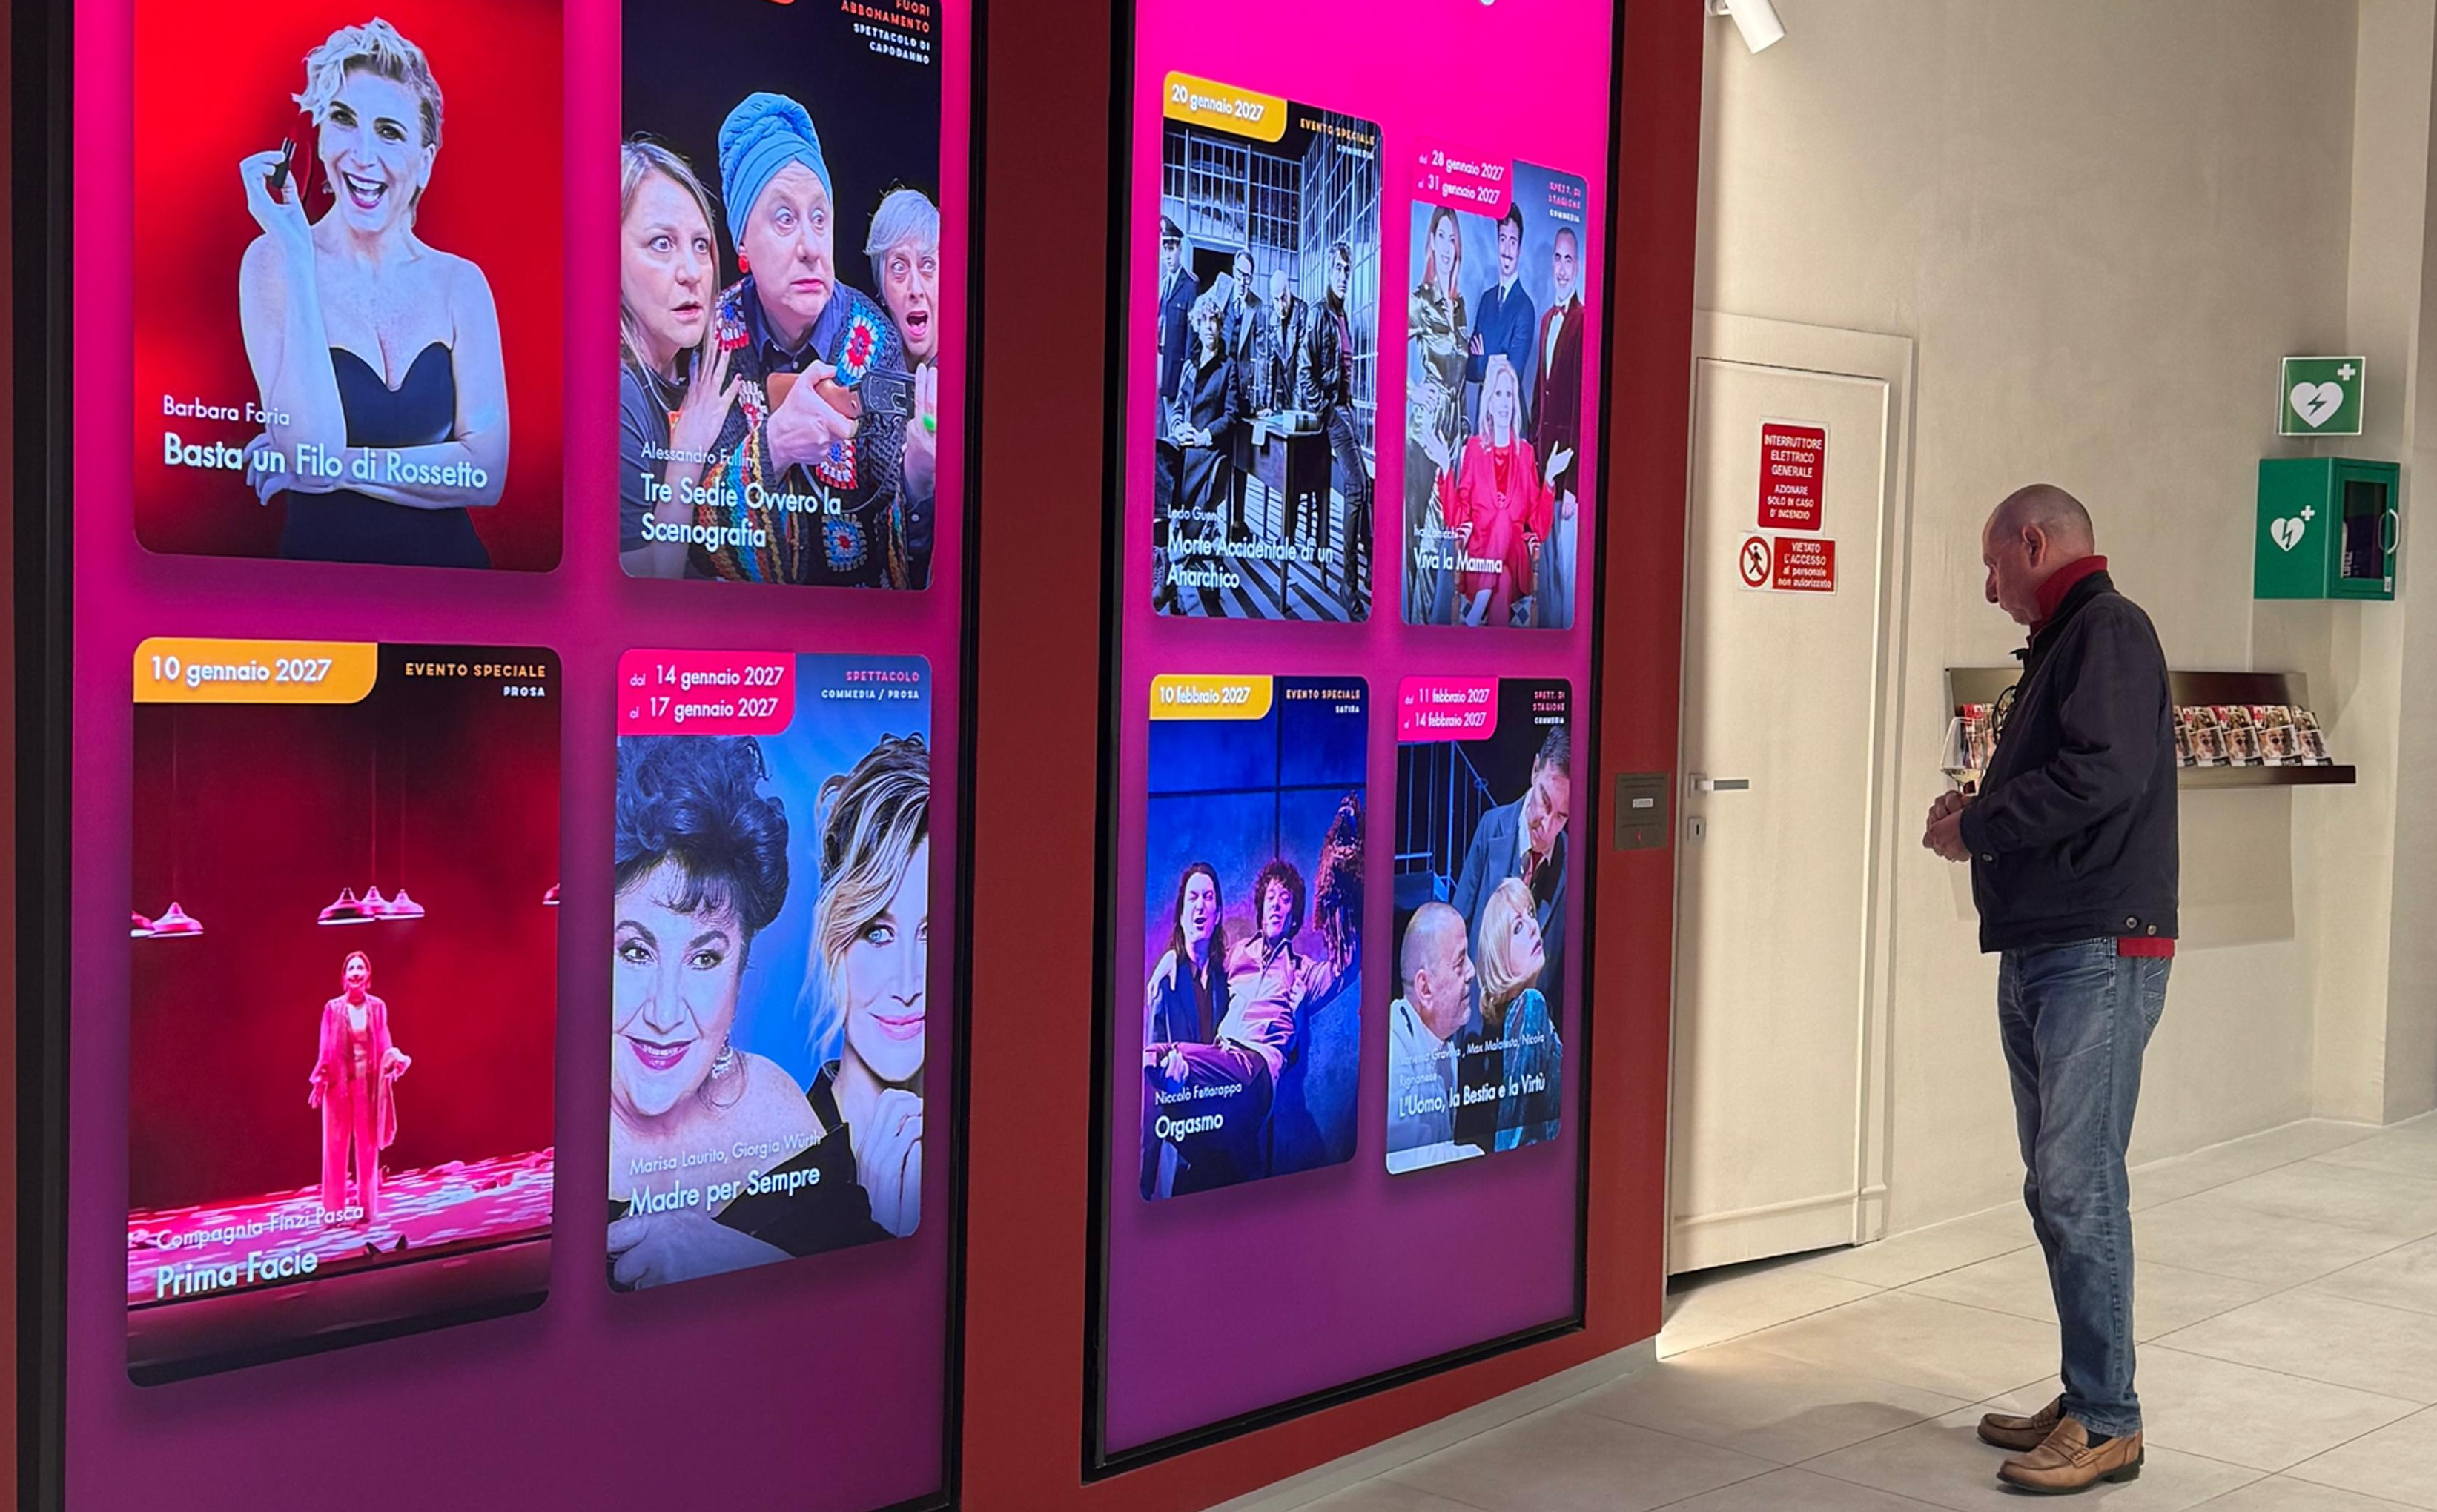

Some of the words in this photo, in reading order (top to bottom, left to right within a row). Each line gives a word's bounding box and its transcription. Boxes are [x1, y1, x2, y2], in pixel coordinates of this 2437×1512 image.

[841, 0, 930, 33] ABBONAMENTO
[896, 0, 930, 16] FUORI
[853, 22, 917, 47] SPETTACOLO
[919, 39, 930, 52] DI
[869, 40, 930, 65] CAPODANNO
[1171, 83, 1188, 104] 20
[1190, 93, 1233, 116] gennaio
[1234, 99, 1265, 122] 2027
[1300, 117, 1333, 136] EVENTO
[1335, 126, 1375, 146] SPECIALE
[1432, 149, 1444, 168] 28
[1446, 159, 1481, 176] gennaio
[1481, 162, 1504, 182] 2027
[1427, 173, 1439, 190] 31
[1442, 182, 1476, 200] gennaio
[1477, 185, 1501, 205] 2027
[163, 394, 239, 421] Barbara
[245, 404, 290, 425] Foria
[641, 440, 716, 464] Alessandro
[1764, 434, 1823, 451] INTERRUTTORE
[164, 431, 242, 471] Basta
[252, 454, 286, 474] un
[296, 443, 343, 477] Filo
[352, 447, 376, 480] di
[387, 454, 488, 489] Rossetto
[1770, 449, 1815, 464] ELETTRICO
[1771, 464, 1813, 478] GENERALE
[641, 473, 672, 503] Tre
[680, 477, 737, 508] Sedie
[744, 482, 818, 516] Ovvero
[824, 488, 841, 515] la
[1768, 495, 1786, 505] SOLO
[1788, 497, 1795, 506] IN
[1795, 497, 1815, 508] CASO
[1774, 484, 1808, 496] AZIONARE
[1778, 509, 1811, 520] INCENDIO
[641, 512, 767, 552] Scenografia
[1167, 528, 1212, 556] Morte
[1216, 534, 1297, 560] Accidentale
[1300, 538, 1315, 561] di
[1317, 547, 1334, 563] un
[1791, 542, 1822, 554] VIETATO
[1413, 546, 1439, 570] Viva
[1443, 547, 1453, 571] la
[1456, 548, 1503, 574] Mamma
[1783, 566, 1790, 575] al
[1792, 567, 1828, 577] personale
[1166, 562, 1240, 589] Anarchico
[1777, 577, 1792, 586] non
[1793, 577, 1832, 589] autorizzato
[151, 655, 180, 680] 10
[186, 658, 270, 689] gennaio
[275, 659, 332, 682] 2027
[406, 663, 468, 677] EVENTO
[474, 665, 546, 678] SPECIALE
[629, 674, 646, 687] dal
[657, 664, 676, 685] 14
[681, 669, 740, 692] gennaio
[744, 666, 785, 686] 2027
[845, 671, 921, 683] SPETTACOLO
[503, 686, 546, 697] PROSA
[821, 689, 876, 700] COMMEDIA
[878, 689, 884, 701] /
[887, 689, 920, 700] PROSA
[1160, 686, 1174, 703] 10
[1177, 686, 1220, 704] febbraio
[1222, 687, 1251, 703] 2027
[1286, 689, 1320, 700] EVENTO
[1322, 689, 1360, 700] SPECIALE
[1419, 688, 1429, 703] 11
[1432, 688, 1467, 704] febbraio
[1467, 689, 1491, 704] 2027
[629, 706, 639, 720] al
[649, 697, 669, 717] 17
[674, 700, 734, 723] gennaio
[738, 698, 779, 718] 2027
[1415, 712, 1427, 727] 14
[1428, 712, 1463, 727] febbraio
[1463, 712, 1487, 727] 2027
[1532, 703, 1565, 712] STAGIONE
[1466, 1042, 1483, 1055] Max
[1155, 1087, 1191, 1106] Niccolò
[1398, 1095, 1446, 1118] L'Uomo,
[1449, 1085, 1460, 1108] la
[1463, 1082, 1496, 1106] Bestia
[1498, 1088, 1506, 1098] e
[1509, 1075, 1518, 1097] la
[1521, 1072, 1546, 1095] Virtù
[1155, 1113, 1224, 1142] Orgasmo
[629, 1151, 678, 1176] Marisa
[681, 1147, 728, 1168] Laurito,
[732, 1141, 781, 1161] Giorgia
[629, 1180, 701, 1218] Madre
[706, 1181, 742, 1212] per
[746, 1165, 821, 1198] Sempre
[156, 1218, 262, 1251] Compagnia
[269, 1211, 310, 1232] Finzi
[316, 1206, 364, 1225] Pasca
[156, 1262, 237, 1299] Prima
[247, 1245, 318, 1284] Facie
